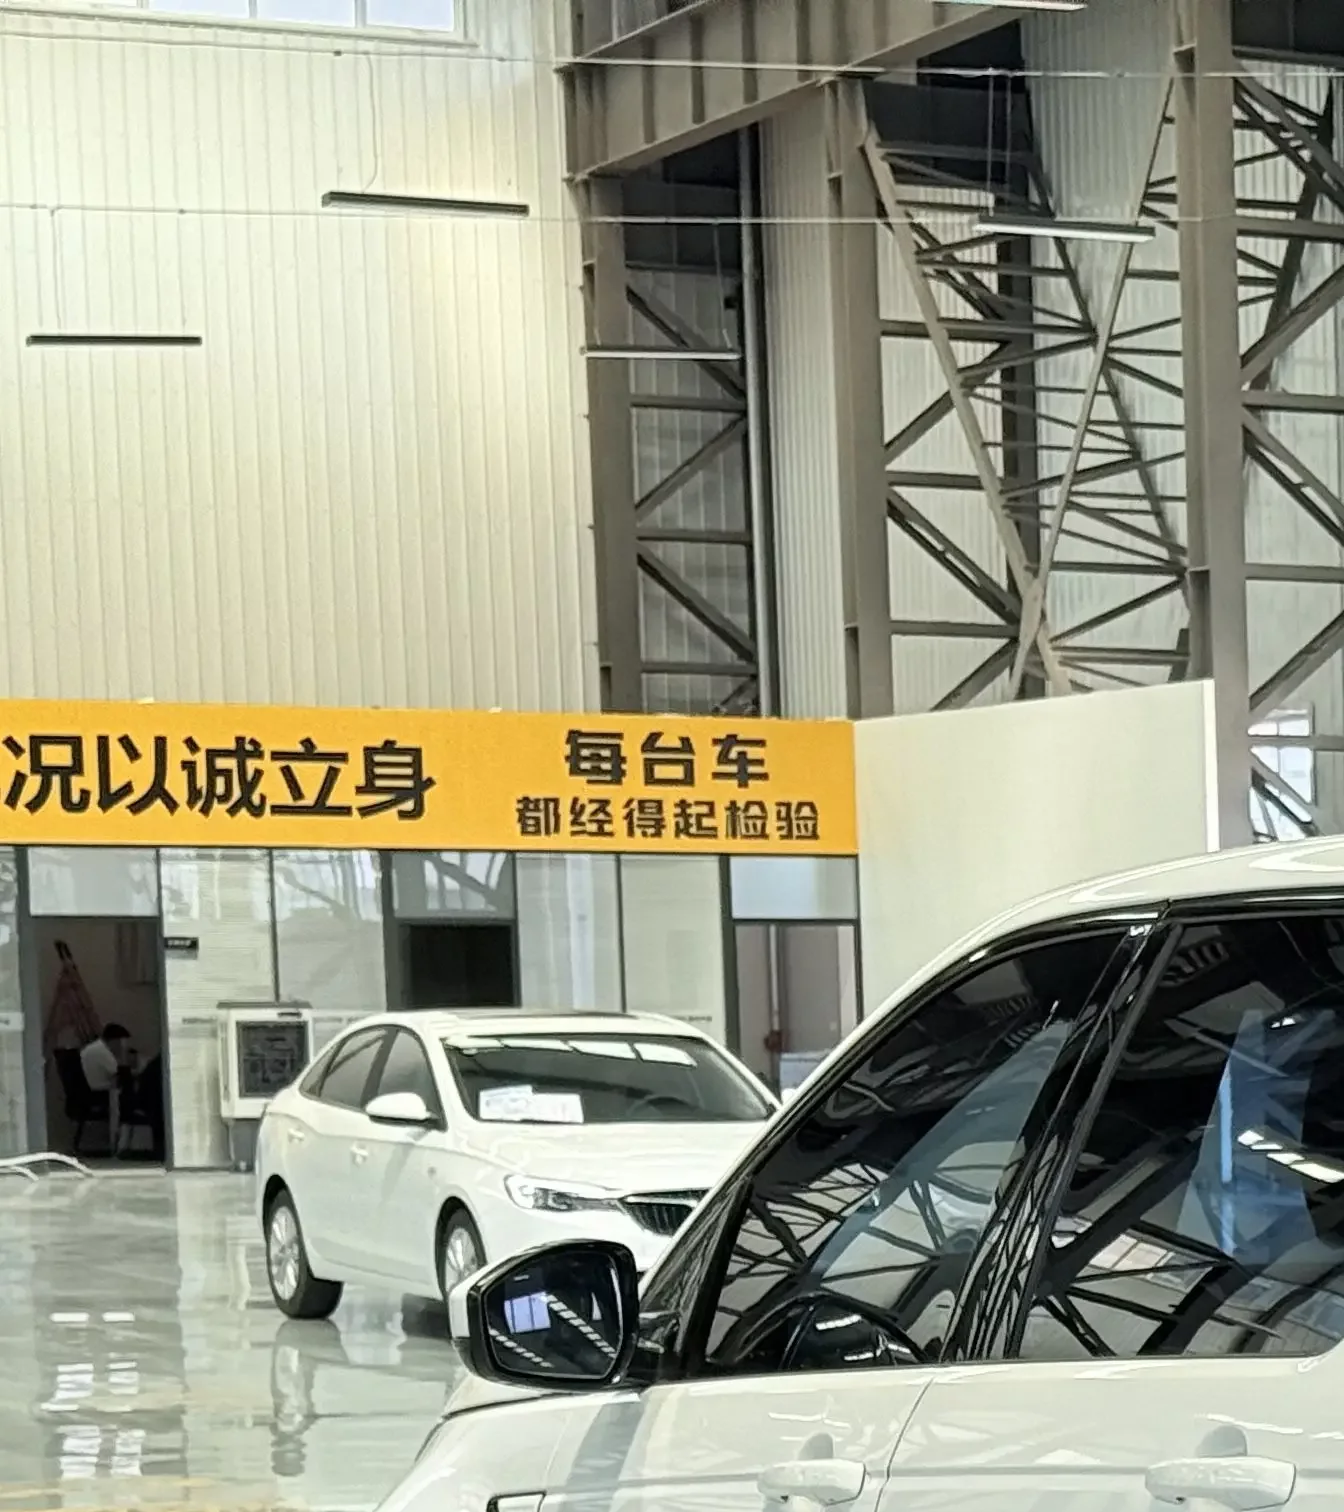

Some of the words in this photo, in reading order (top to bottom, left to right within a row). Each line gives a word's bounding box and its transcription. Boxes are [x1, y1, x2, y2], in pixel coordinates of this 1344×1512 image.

[2, 734, 437, 821] 况以诚立身
[564, 729, 769, 788] 每台车
[515, 796, 820, 841] 都经得起检验
